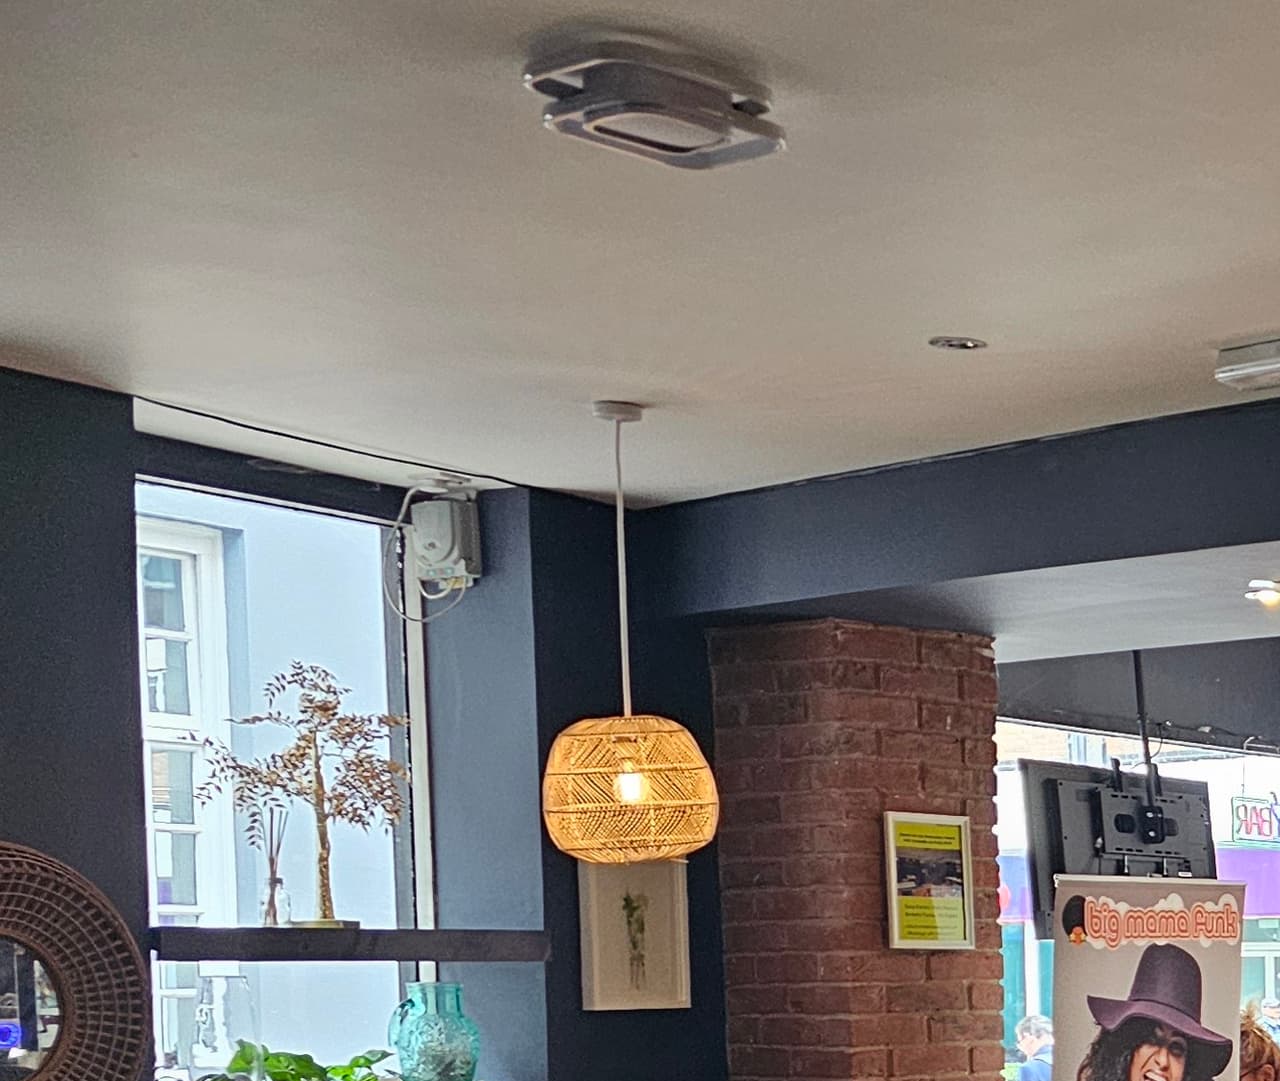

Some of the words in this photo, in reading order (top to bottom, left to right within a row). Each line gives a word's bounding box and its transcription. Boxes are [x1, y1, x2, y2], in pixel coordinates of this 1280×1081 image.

[1085, 898, 1120, 949] big
[1124, 909, 1191, 939] mama
[1193, 901, 1239, 940] funk
